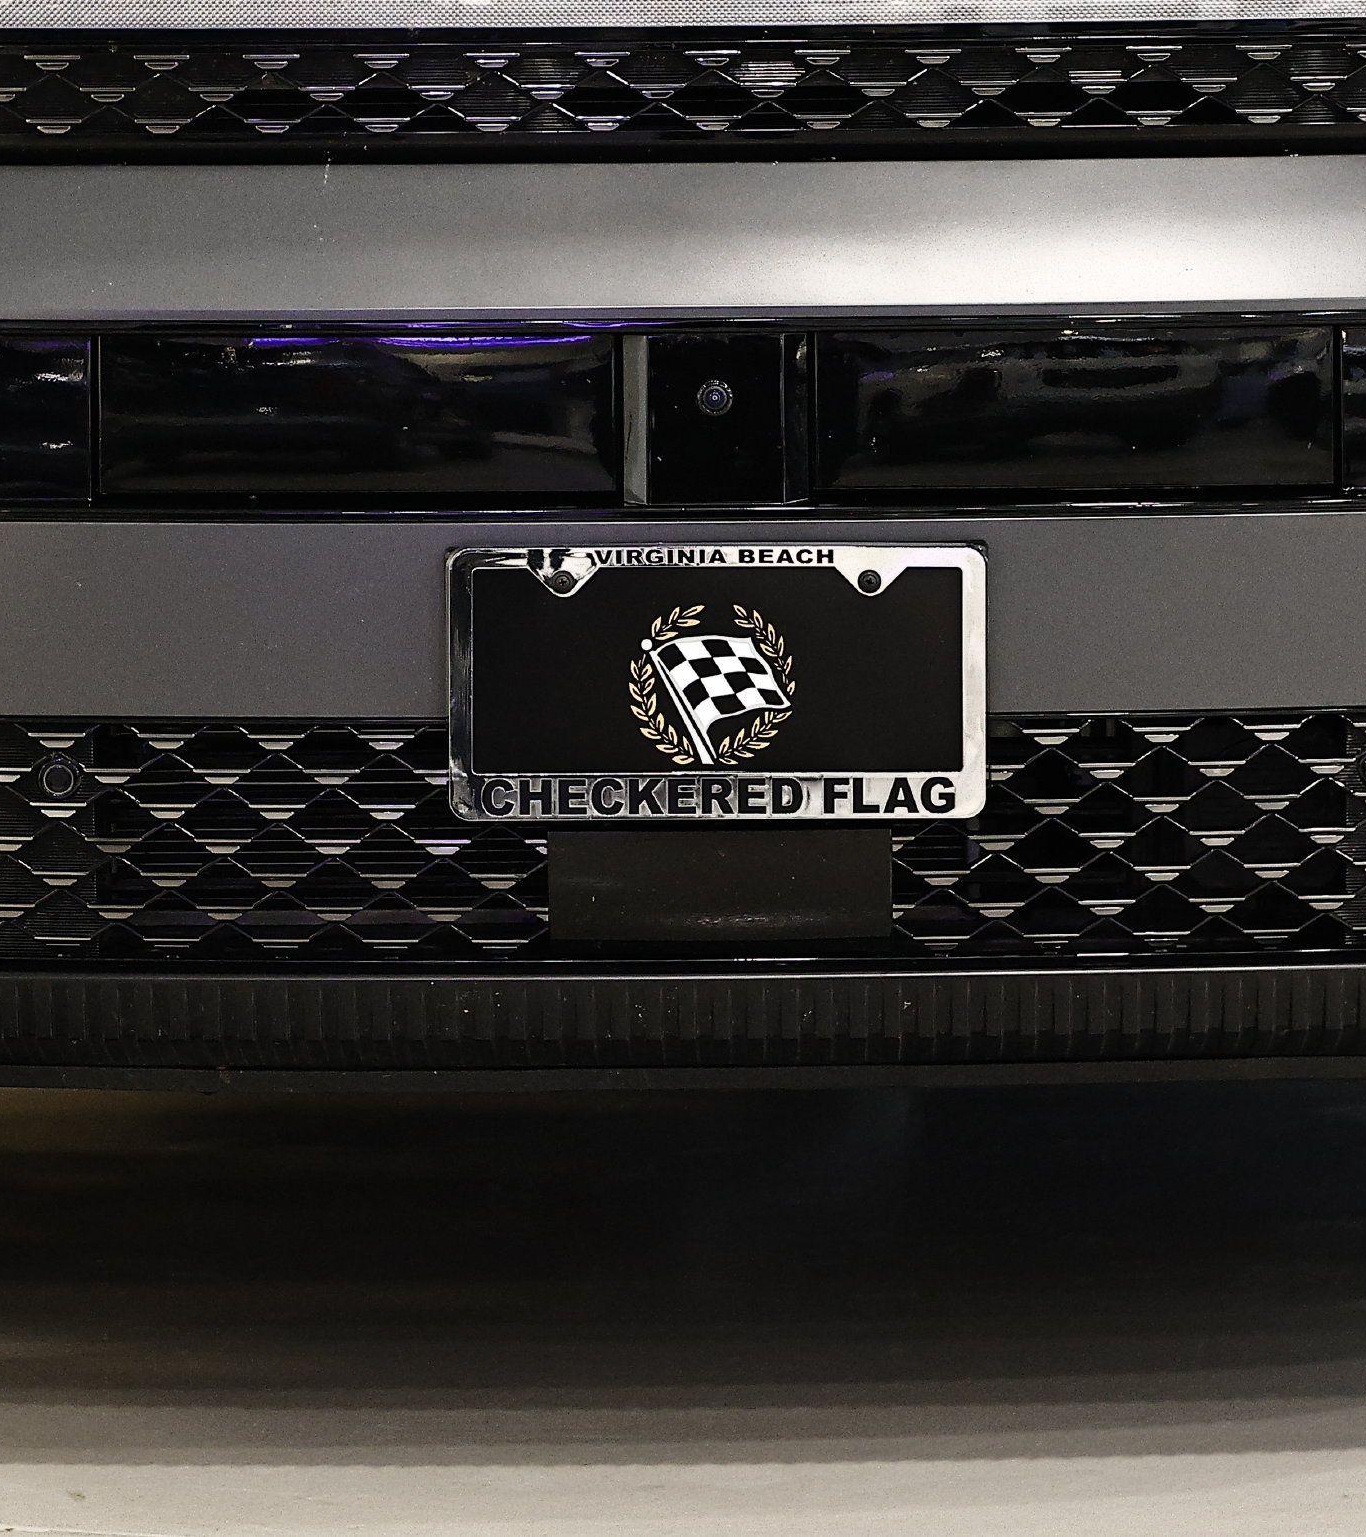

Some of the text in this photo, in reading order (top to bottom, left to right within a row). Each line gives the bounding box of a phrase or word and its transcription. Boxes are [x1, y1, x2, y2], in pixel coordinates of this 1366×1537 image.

[594, 548, 835, 565] VIRGINIA BEACH
[481, 776, 957, 816] CHECKERED FLAG
